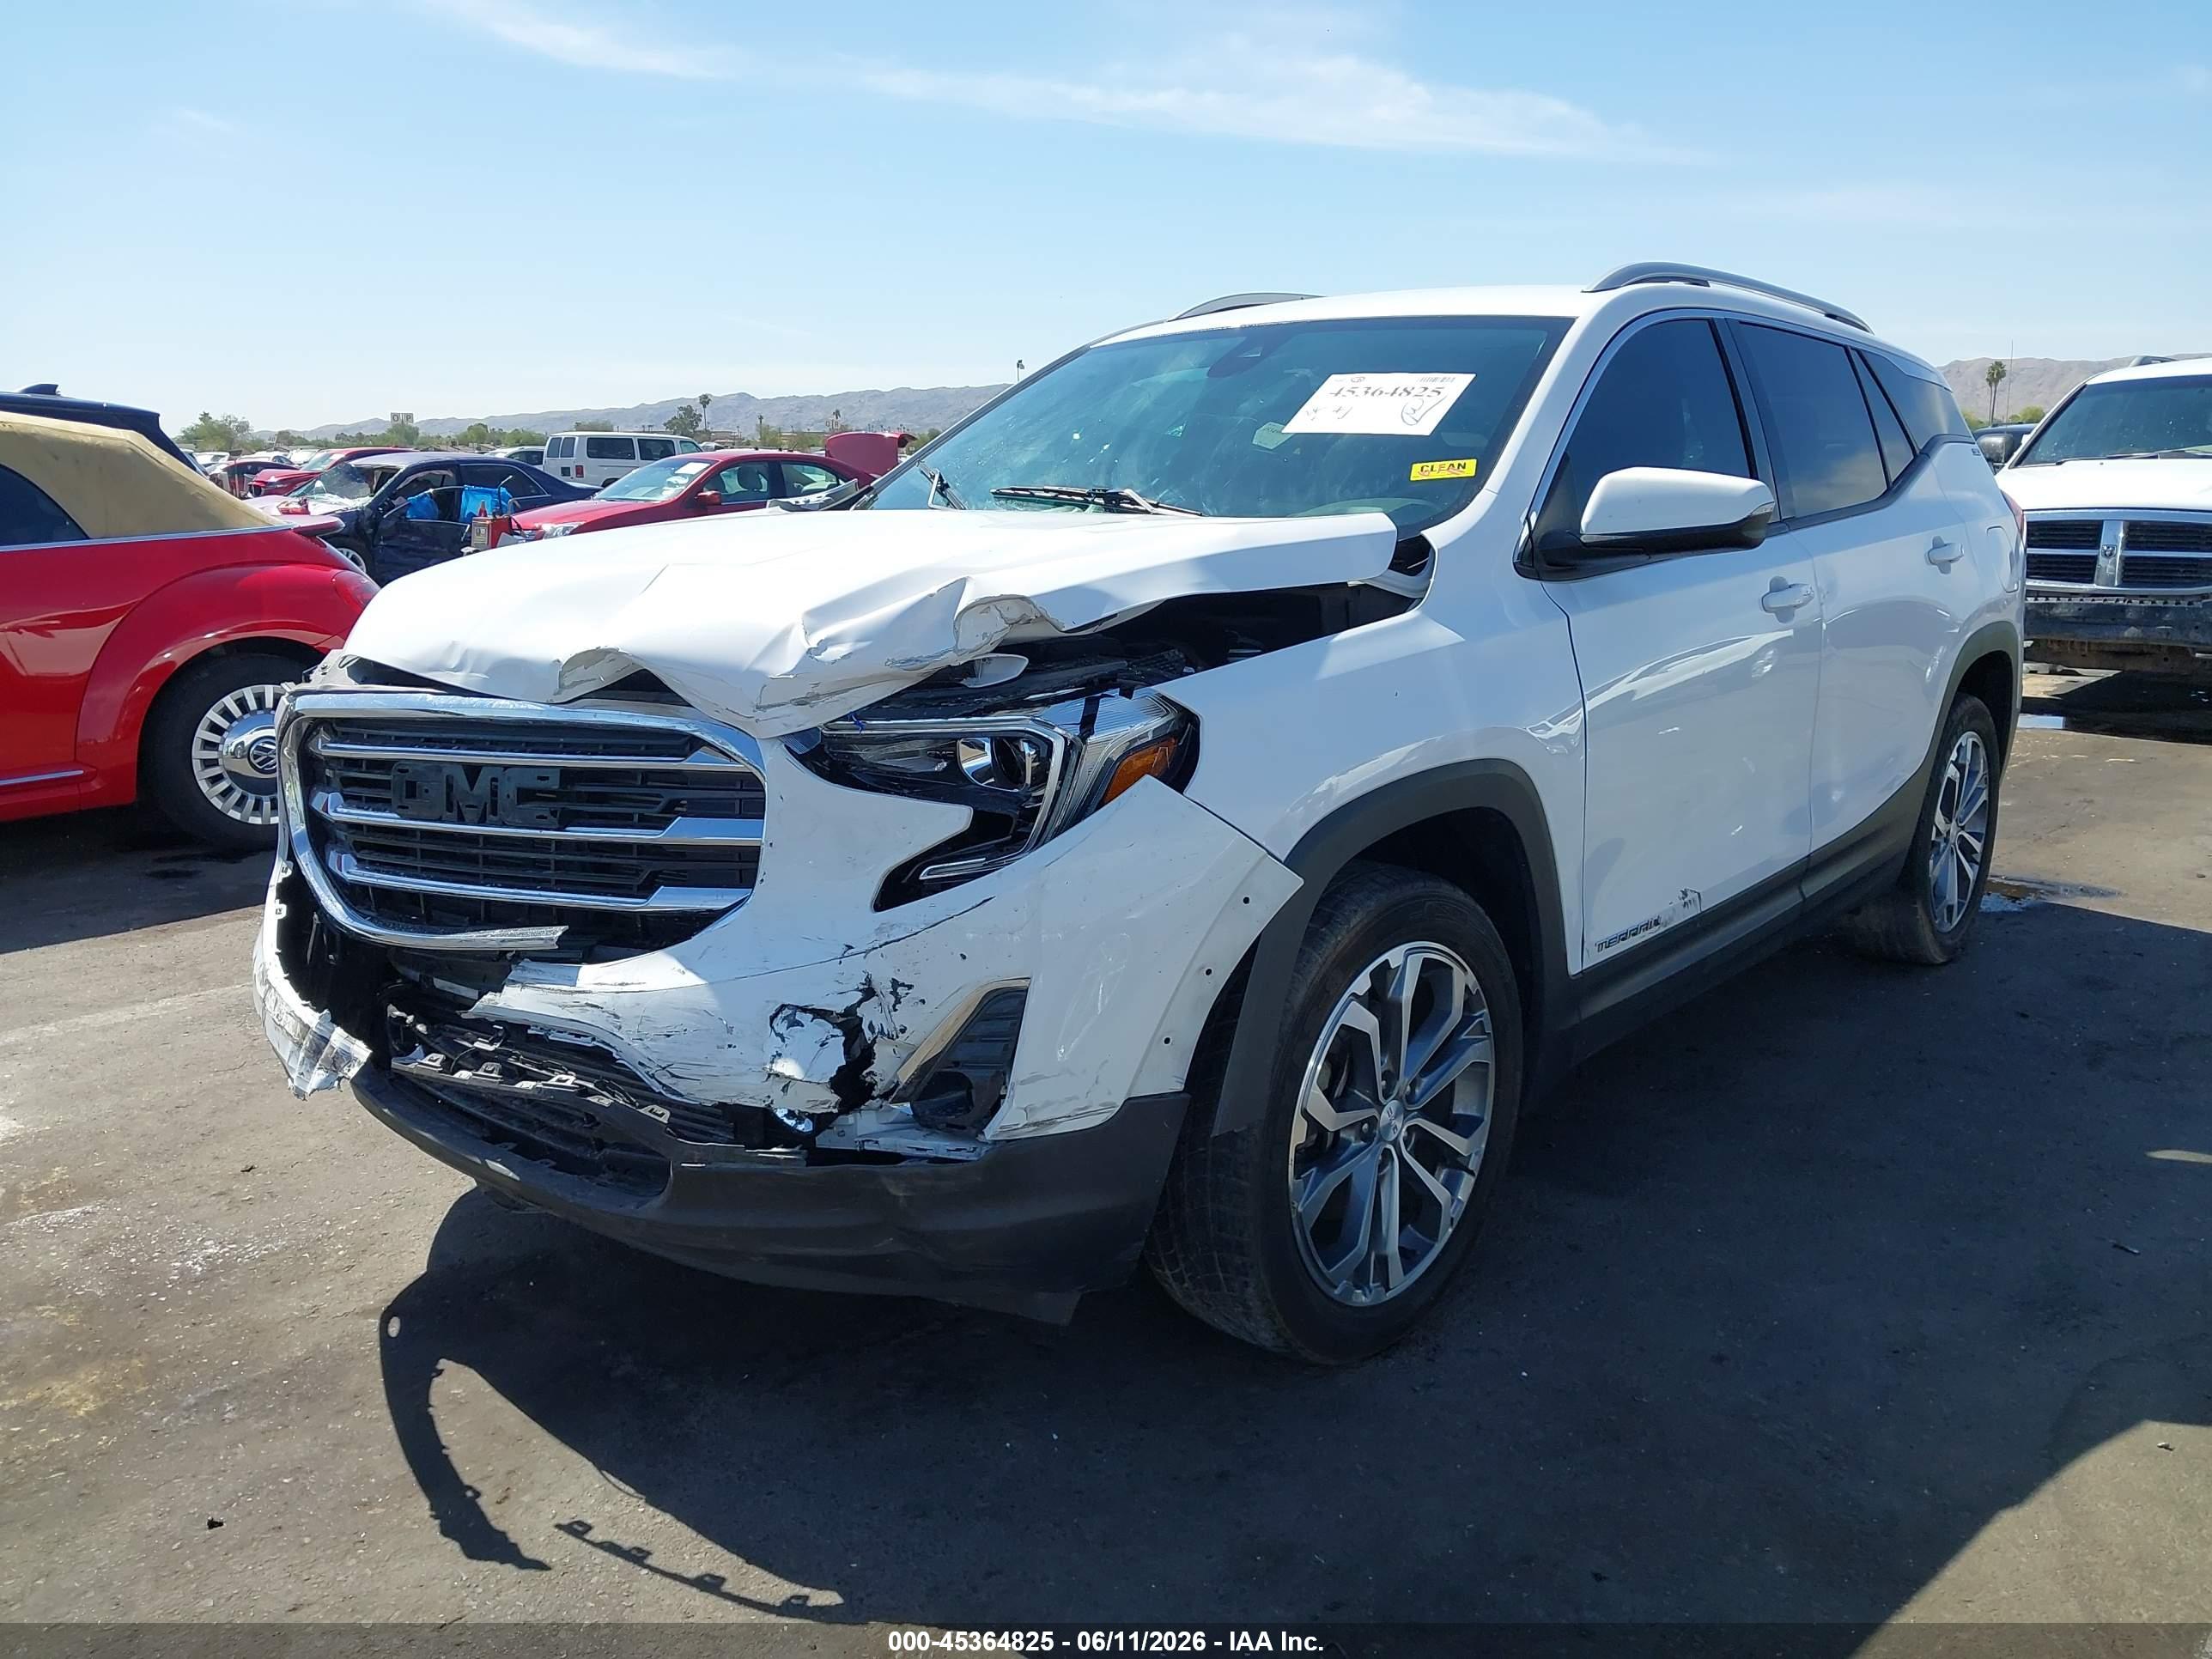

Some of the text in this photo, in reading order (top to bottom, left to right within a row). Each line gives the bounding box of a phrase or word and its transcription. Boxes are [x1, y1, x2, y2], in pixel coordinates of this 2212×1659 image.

[1328, 386, 1445, 398] 45364825
[1420, 462, 1467, 472] CLEAN
[392, 761, 561, 828] GMC
